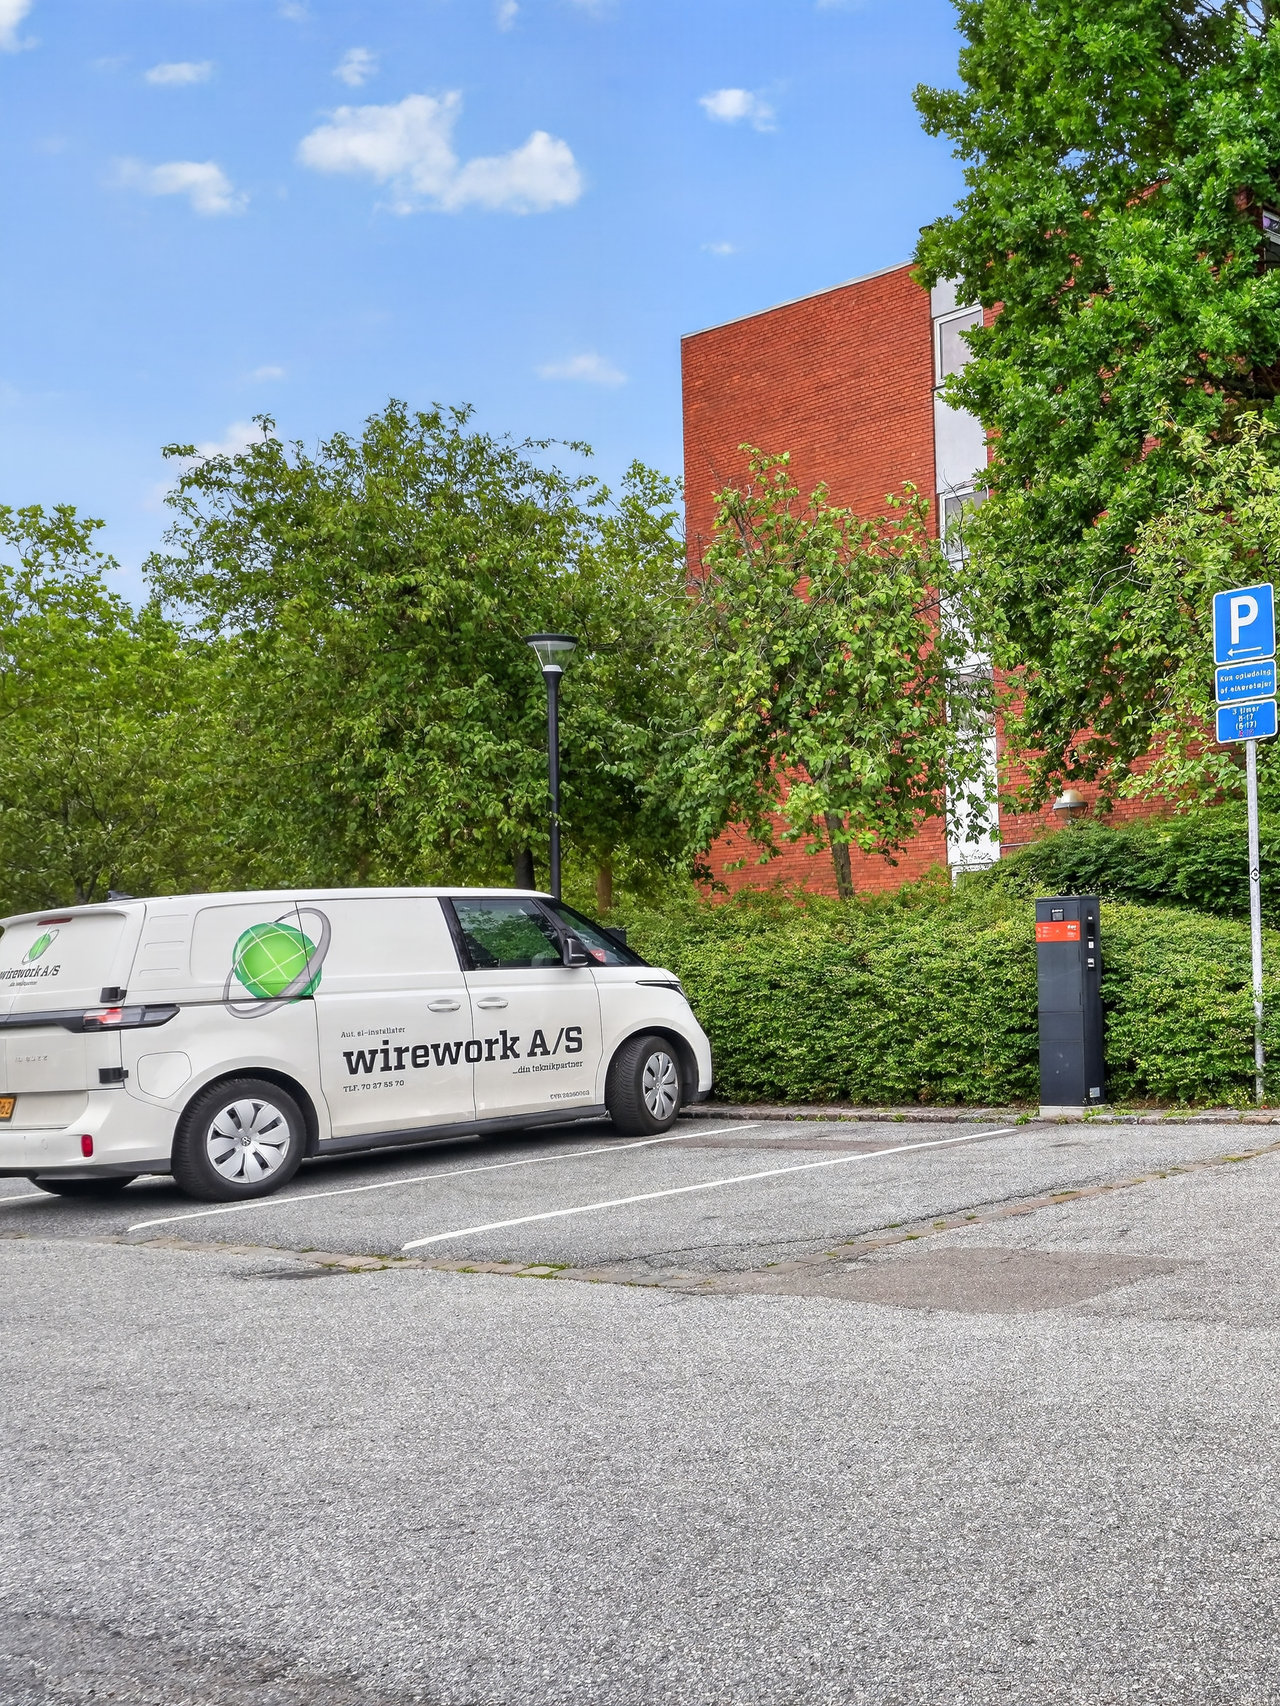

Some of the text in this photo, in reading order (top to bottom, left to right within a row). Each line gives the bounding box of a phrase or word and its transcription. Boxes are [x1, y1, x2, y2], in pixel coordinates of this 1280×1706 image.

[1230, 595, 1258, 645] P
[0, 965, 61, 980] wirework A/S
[343, 1026, 583, 1075] wirework A/S
